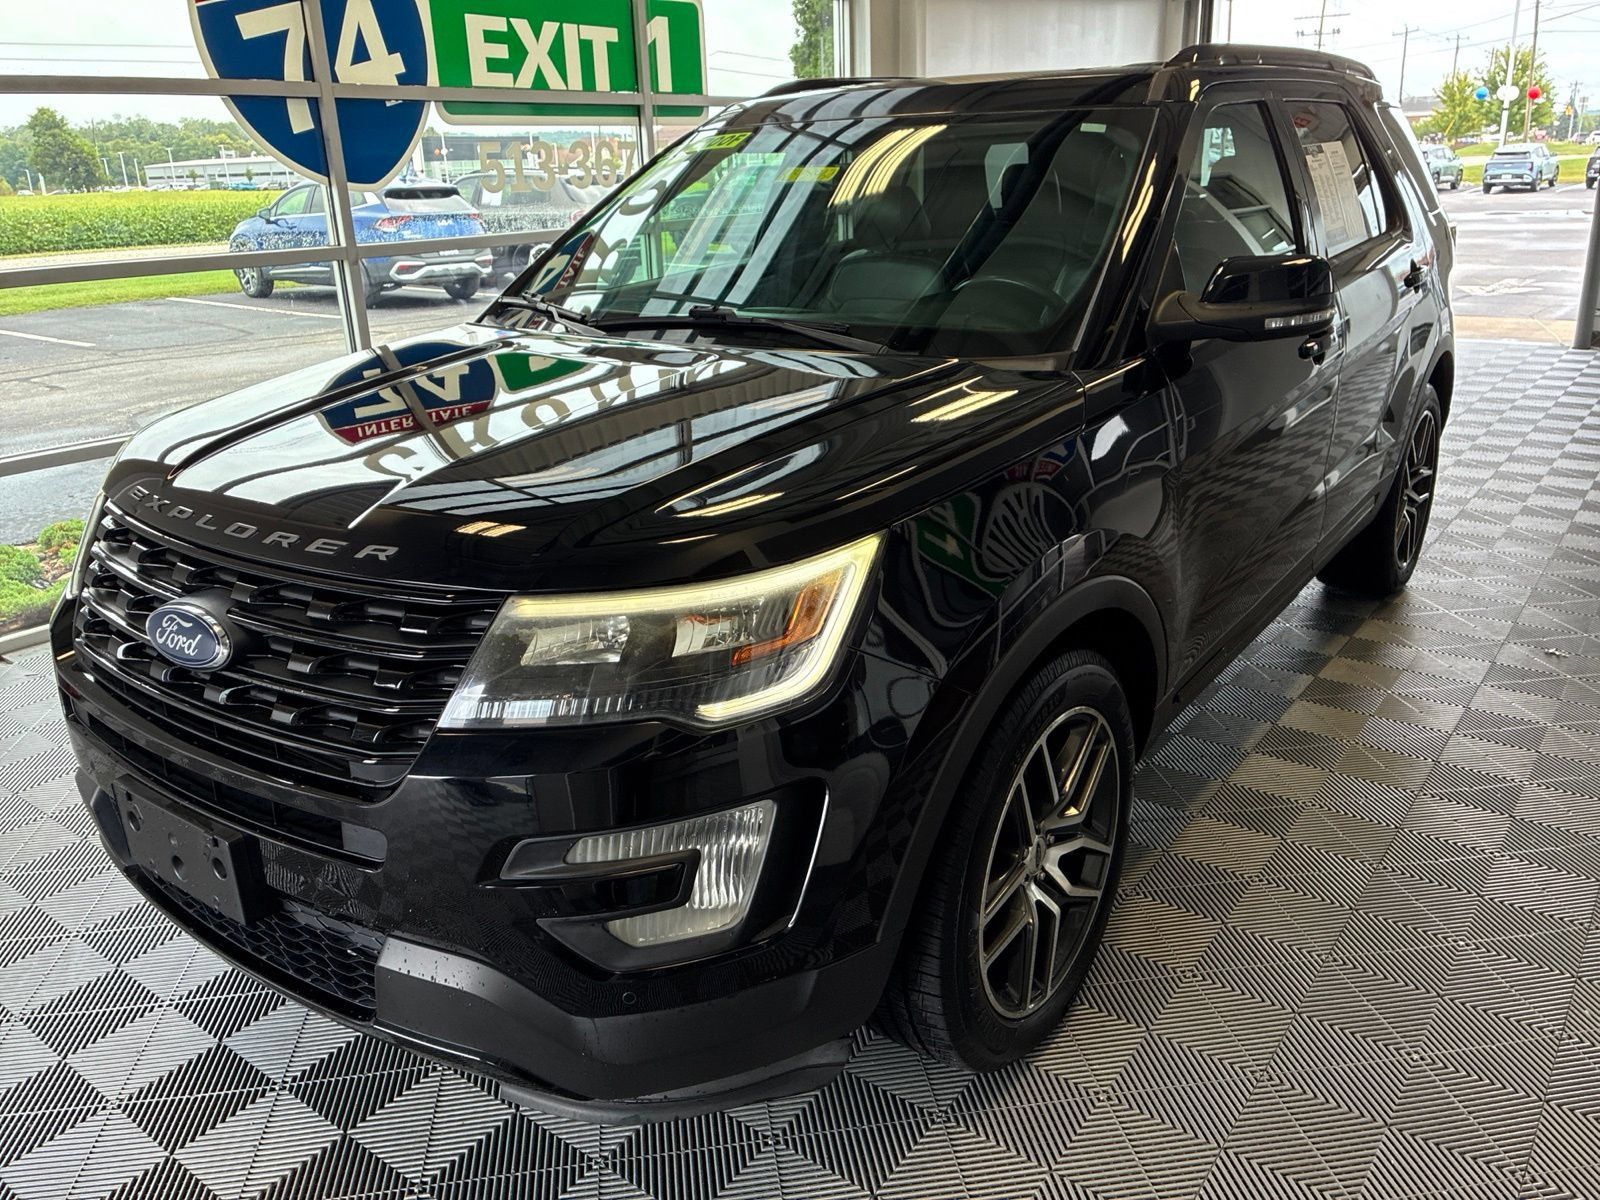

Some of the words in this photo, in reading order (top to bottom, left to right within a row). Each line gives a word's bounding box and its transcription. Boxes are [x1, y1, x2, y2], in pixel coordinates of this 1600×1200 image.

[235, 0, 406, 134] 74
[464, 13, 619, 92] EXIT
[646, 15, 673, 92] 1
[127, 485, 399, 561] EXPLORER
[156, 614, 202, 656] Ford
